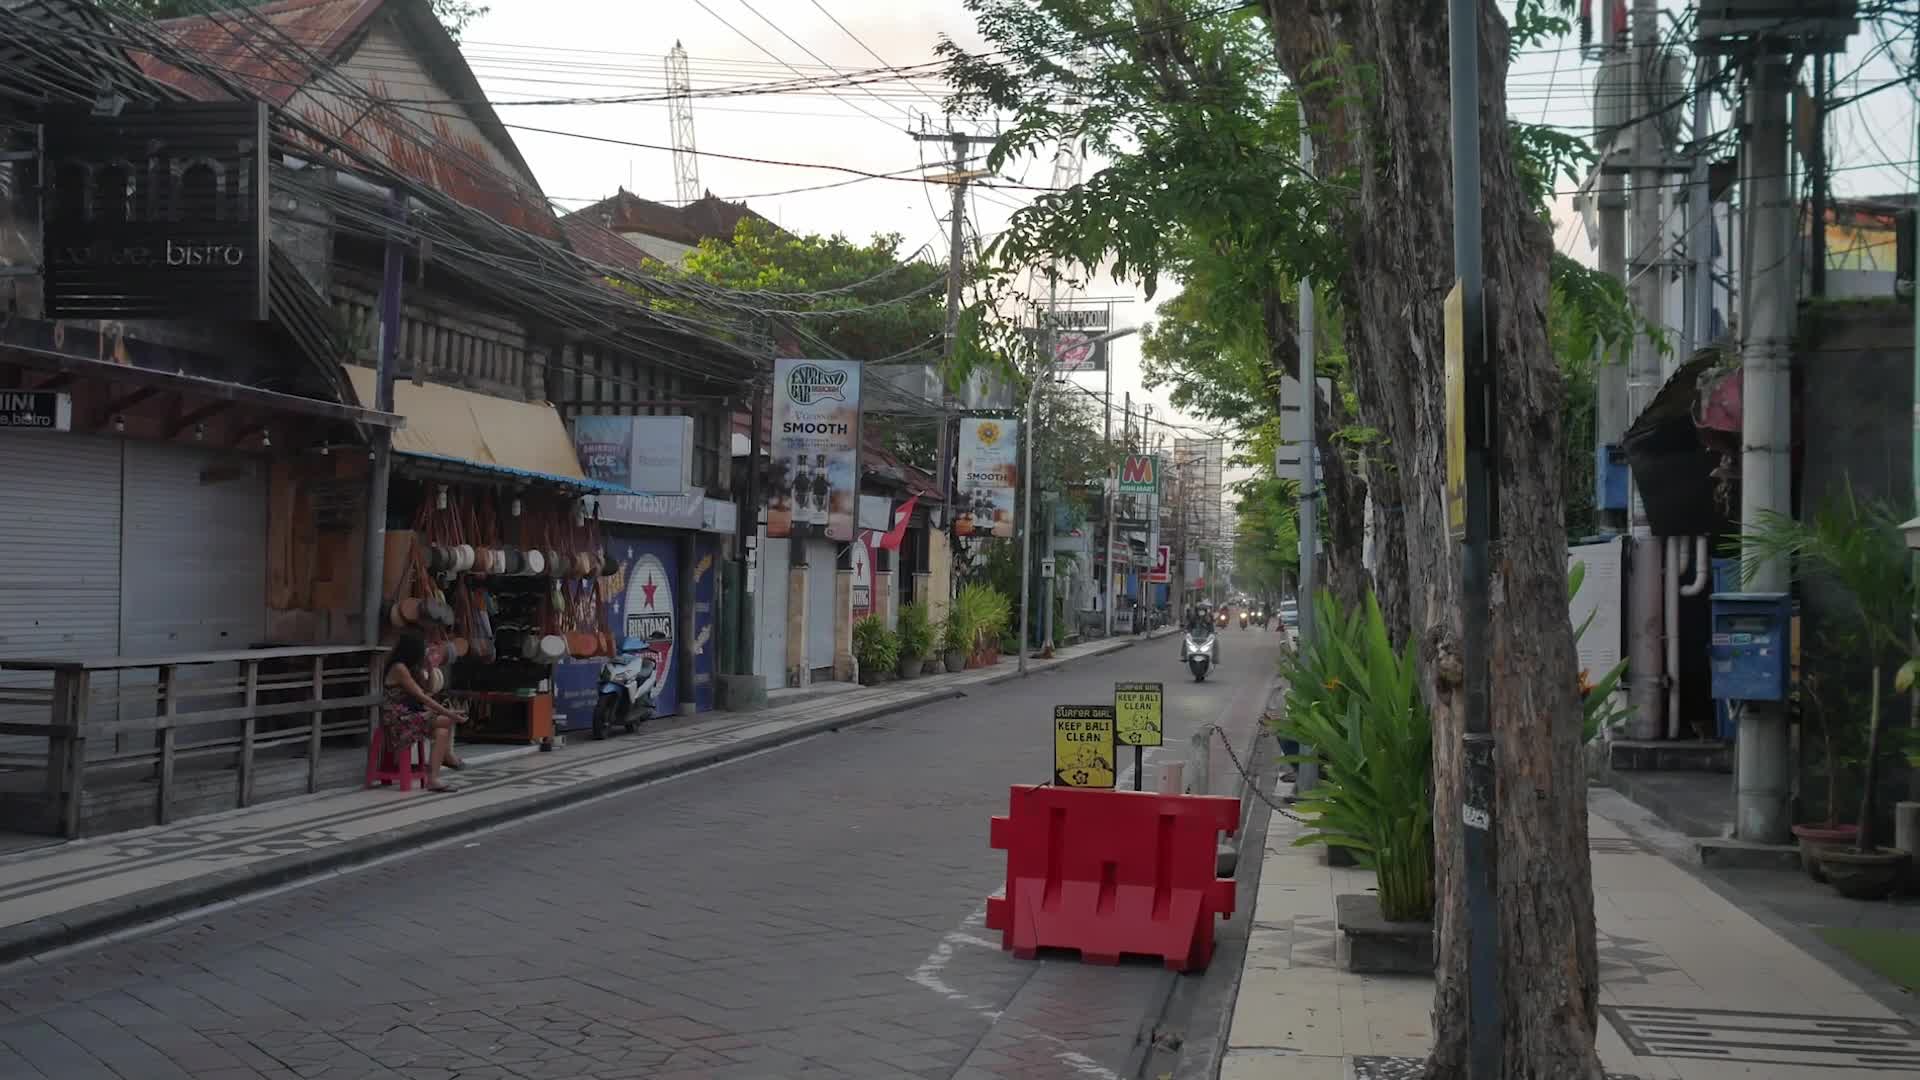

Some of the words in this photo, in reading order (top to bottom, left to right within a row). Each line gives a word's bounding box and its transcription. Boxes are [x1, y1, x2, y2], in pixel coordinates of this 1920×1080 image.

[165, 240, 244, 266] bistro
[791, 366, 844, 385] ESPRESSO
[791, 385, 811, 402] BAR
[783, 423, 848, 435] SMOOTH
[589, 456, 616, 467] ICE
[967, 472, 1008, 481] SMOOTH
[628, 617, 671, 640] BINTANG
[1118, 693, 1137, 702] KEEP
[1139, 694, 1159, 702] BALI
[1124, 702, 1152, 710] CLEAN
[1058, 721, 1082, 731] KEEP
[1085, 722, 1109, 731] BALI
[1066, 732, 1101, 742] CLEAN
